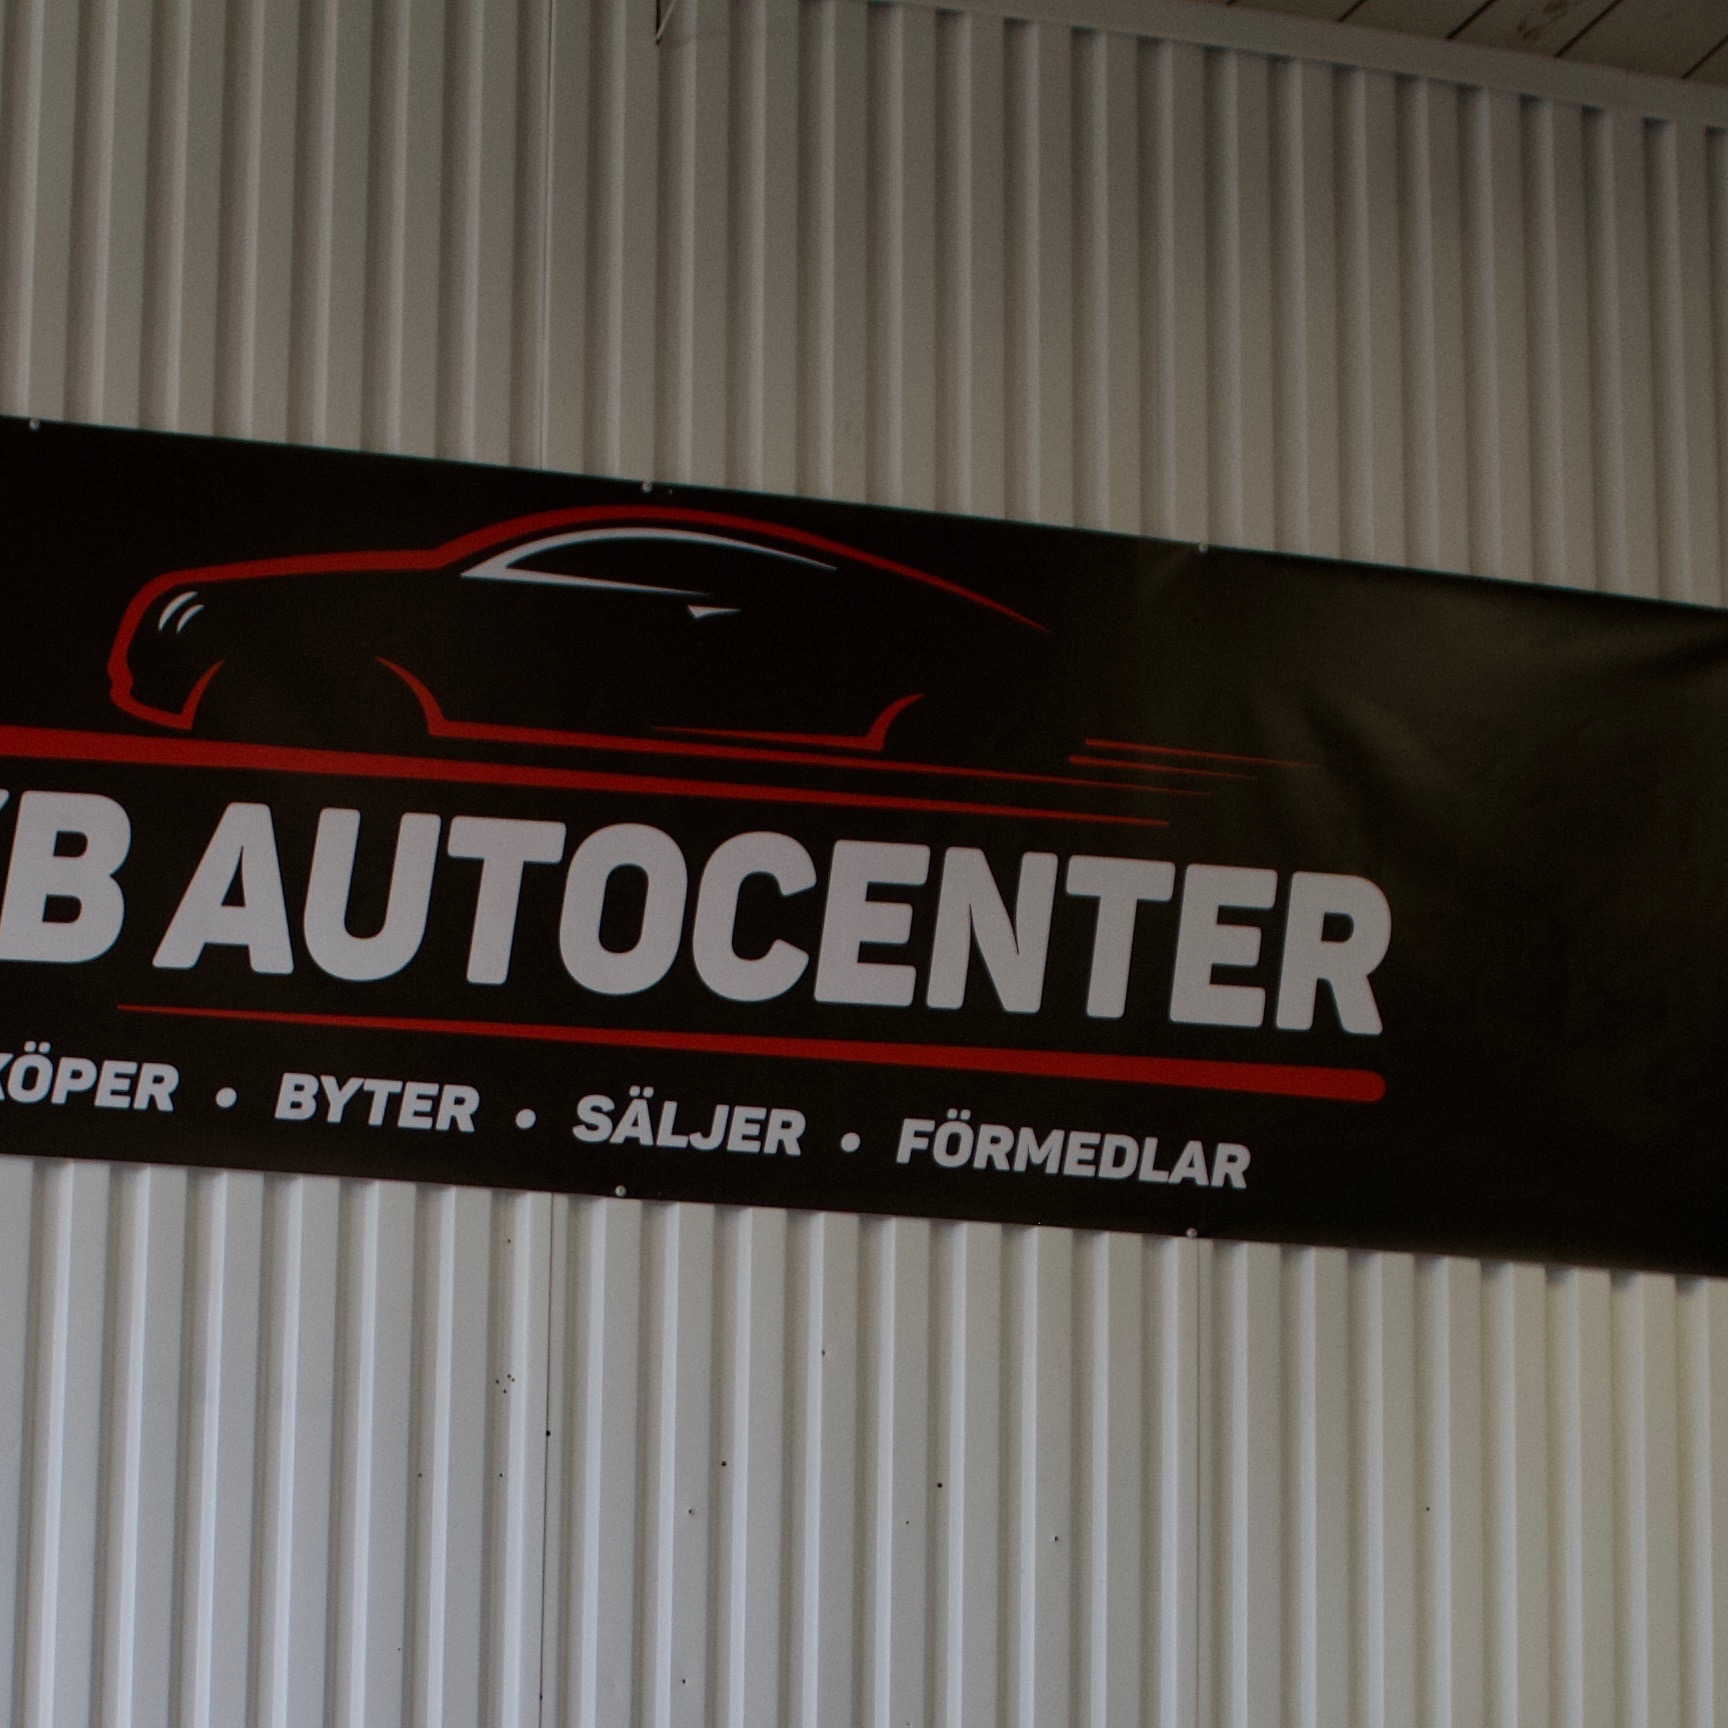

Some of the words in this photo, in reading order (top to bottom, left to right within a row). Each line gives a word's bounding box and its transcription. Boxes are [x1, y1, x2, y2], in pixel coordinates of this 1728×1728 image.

[152, 802, 1392, 1036] AUTOCENTER
[274, 1072, 480, 1132] BYTER
[572, 1085, 806, 1156] SÄLJER
[896, 1108, 1251, 1189] FÖRMEDLAR
